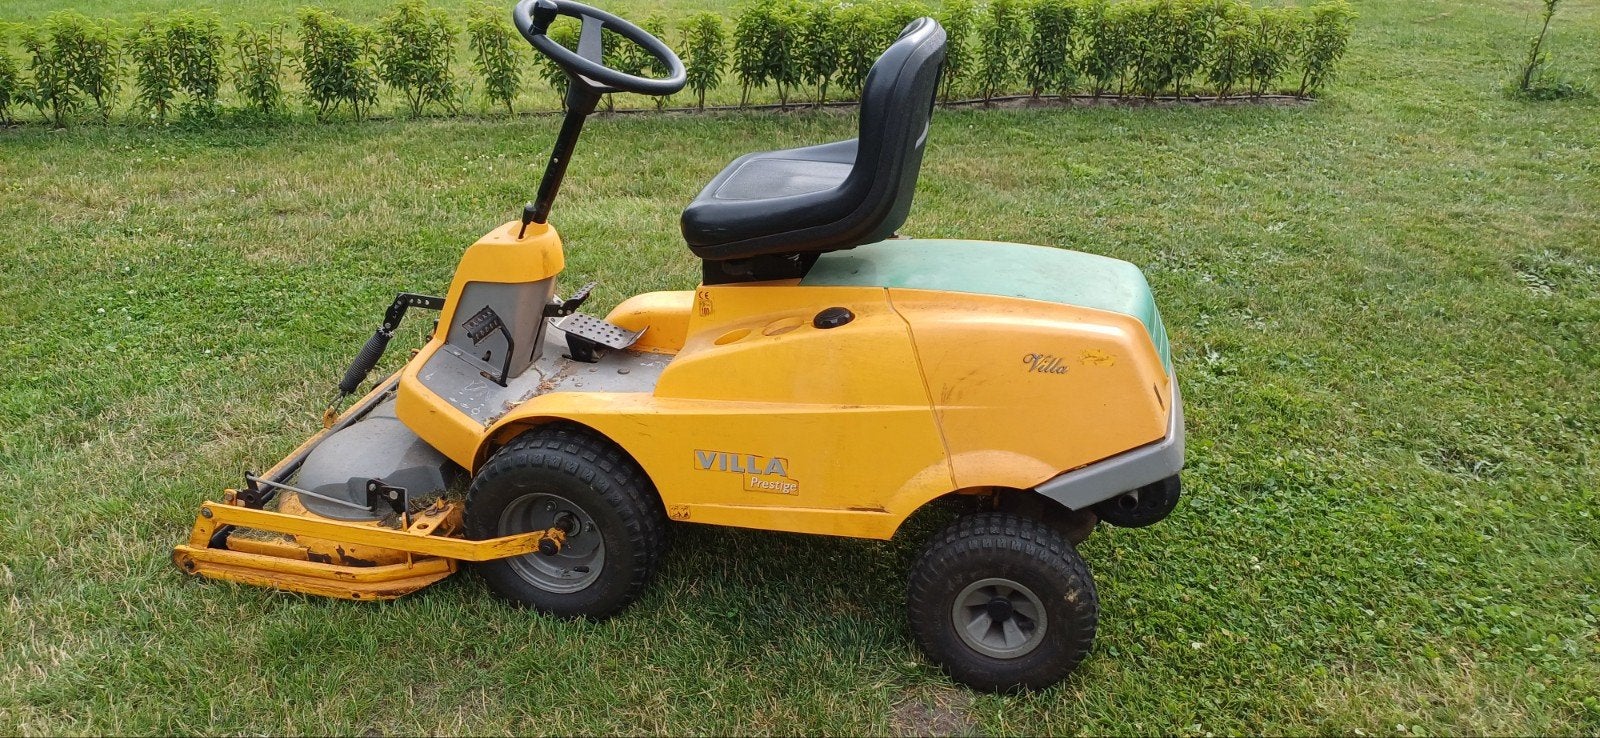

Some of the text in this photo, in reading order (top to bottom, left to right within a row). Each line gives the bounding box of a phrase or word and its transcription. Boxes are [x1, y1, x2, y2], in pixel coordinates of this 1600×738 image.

[1022, 353, 1069, 374] Villa
[696, 450, 787, 477] VILLA
[750, 476, 797, 494] Prestige
